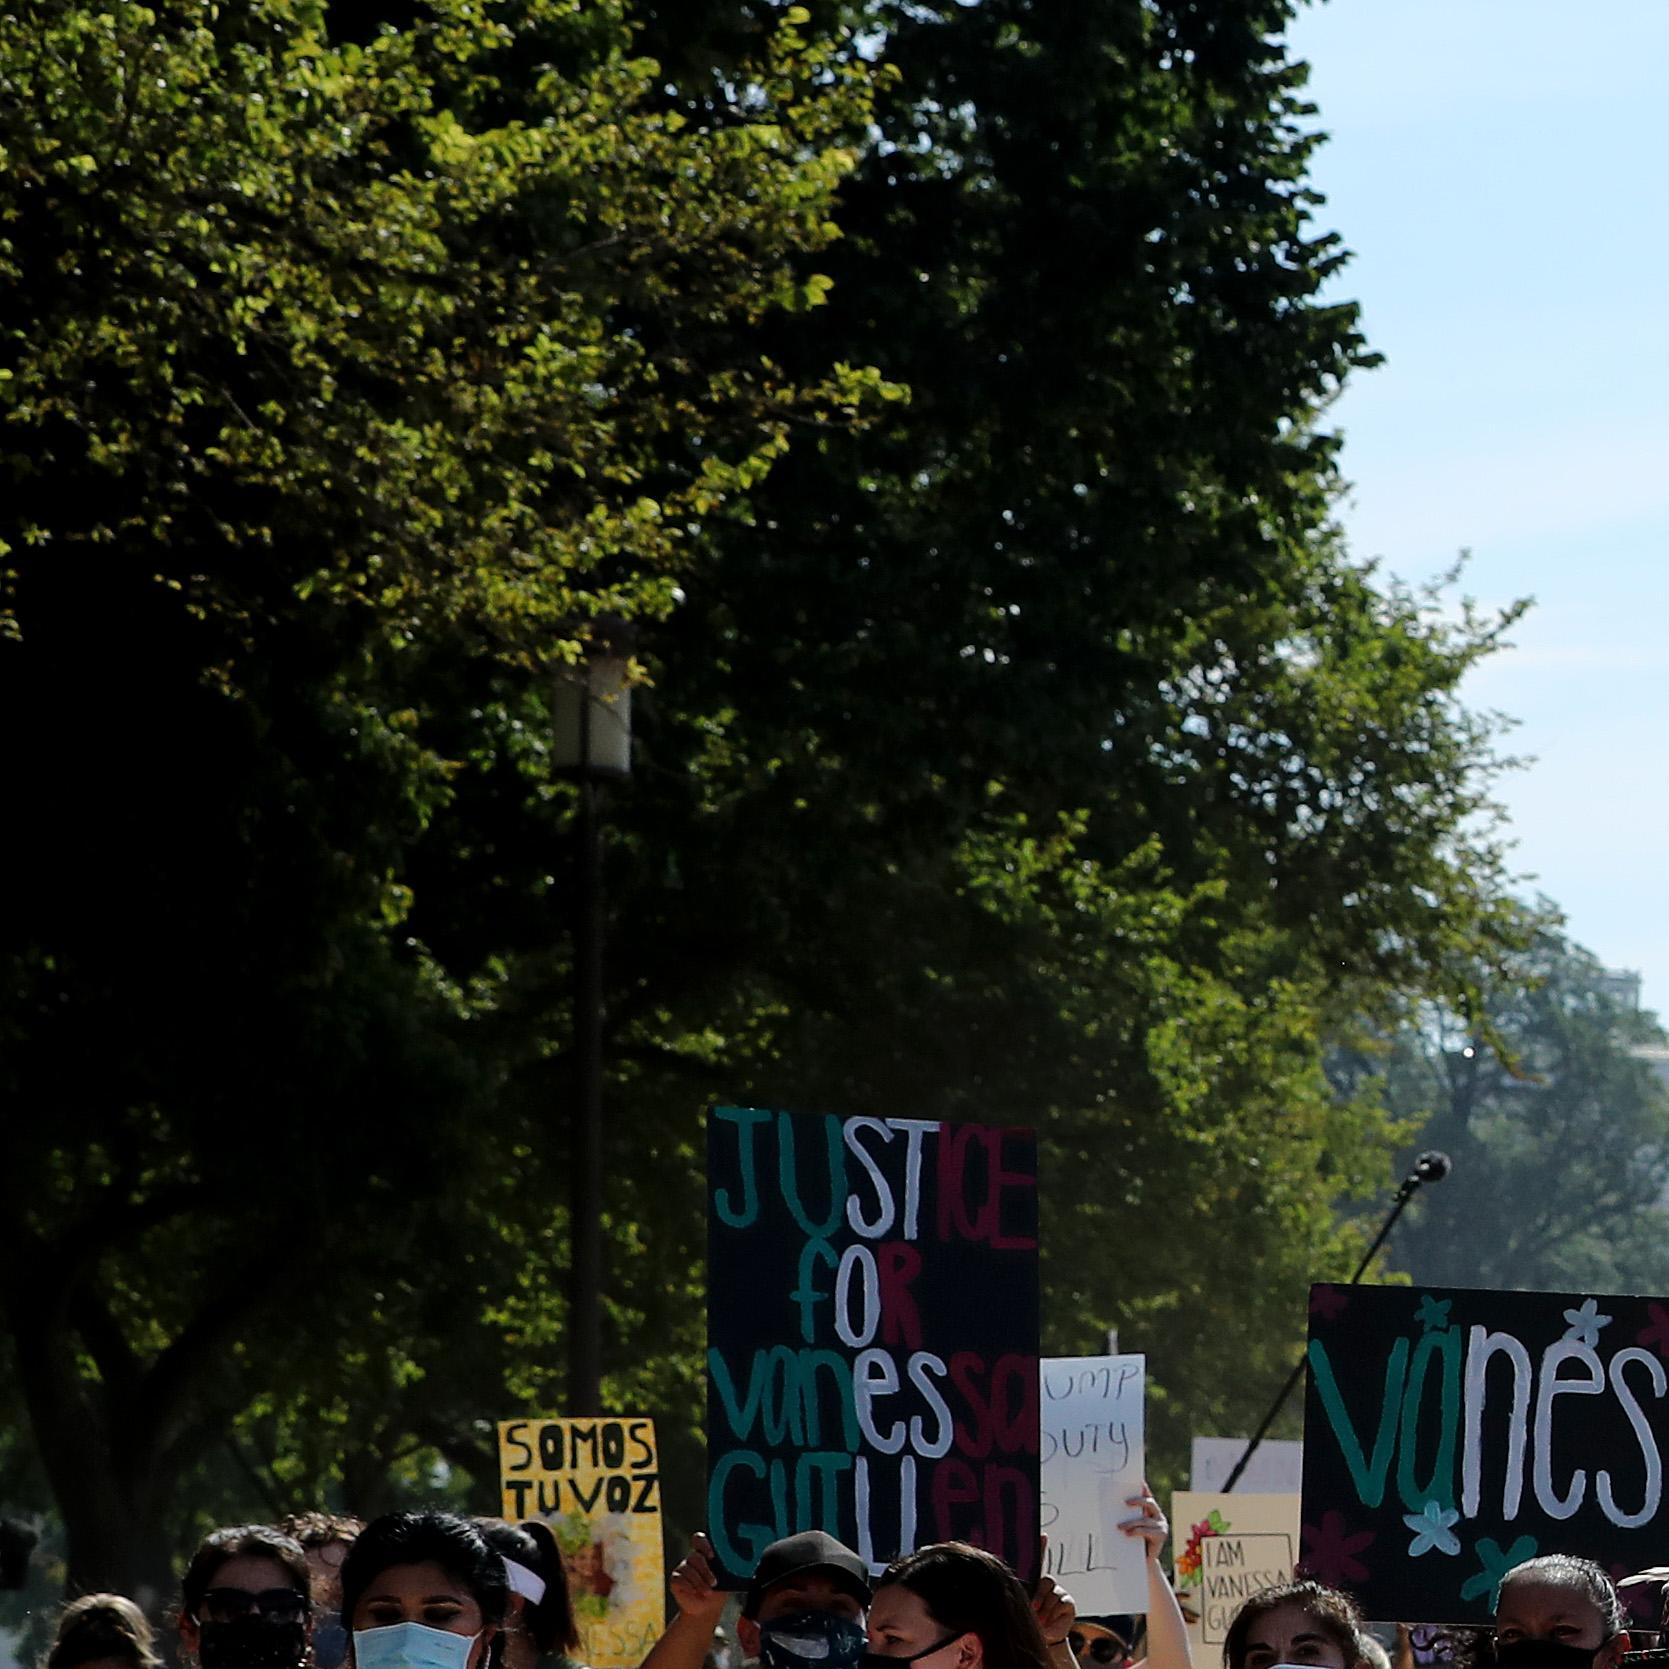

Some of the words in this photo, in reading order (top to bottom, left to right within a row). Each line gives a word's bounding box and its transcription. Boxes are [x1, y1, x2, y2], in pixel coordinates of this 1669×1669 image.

[714, 1107, 1036, 1250] JUSTICE
[1044, 1363, 1140, 1400] UMP
[506, 1423, 653, 1471] SOMOS
[506, 1480, 560, 1519] TU
[568, 1474, 660, 1513] VOZ
[1205, 1540, 1213, 1566] I
[1216, 1541, 1244, 1566] AM
